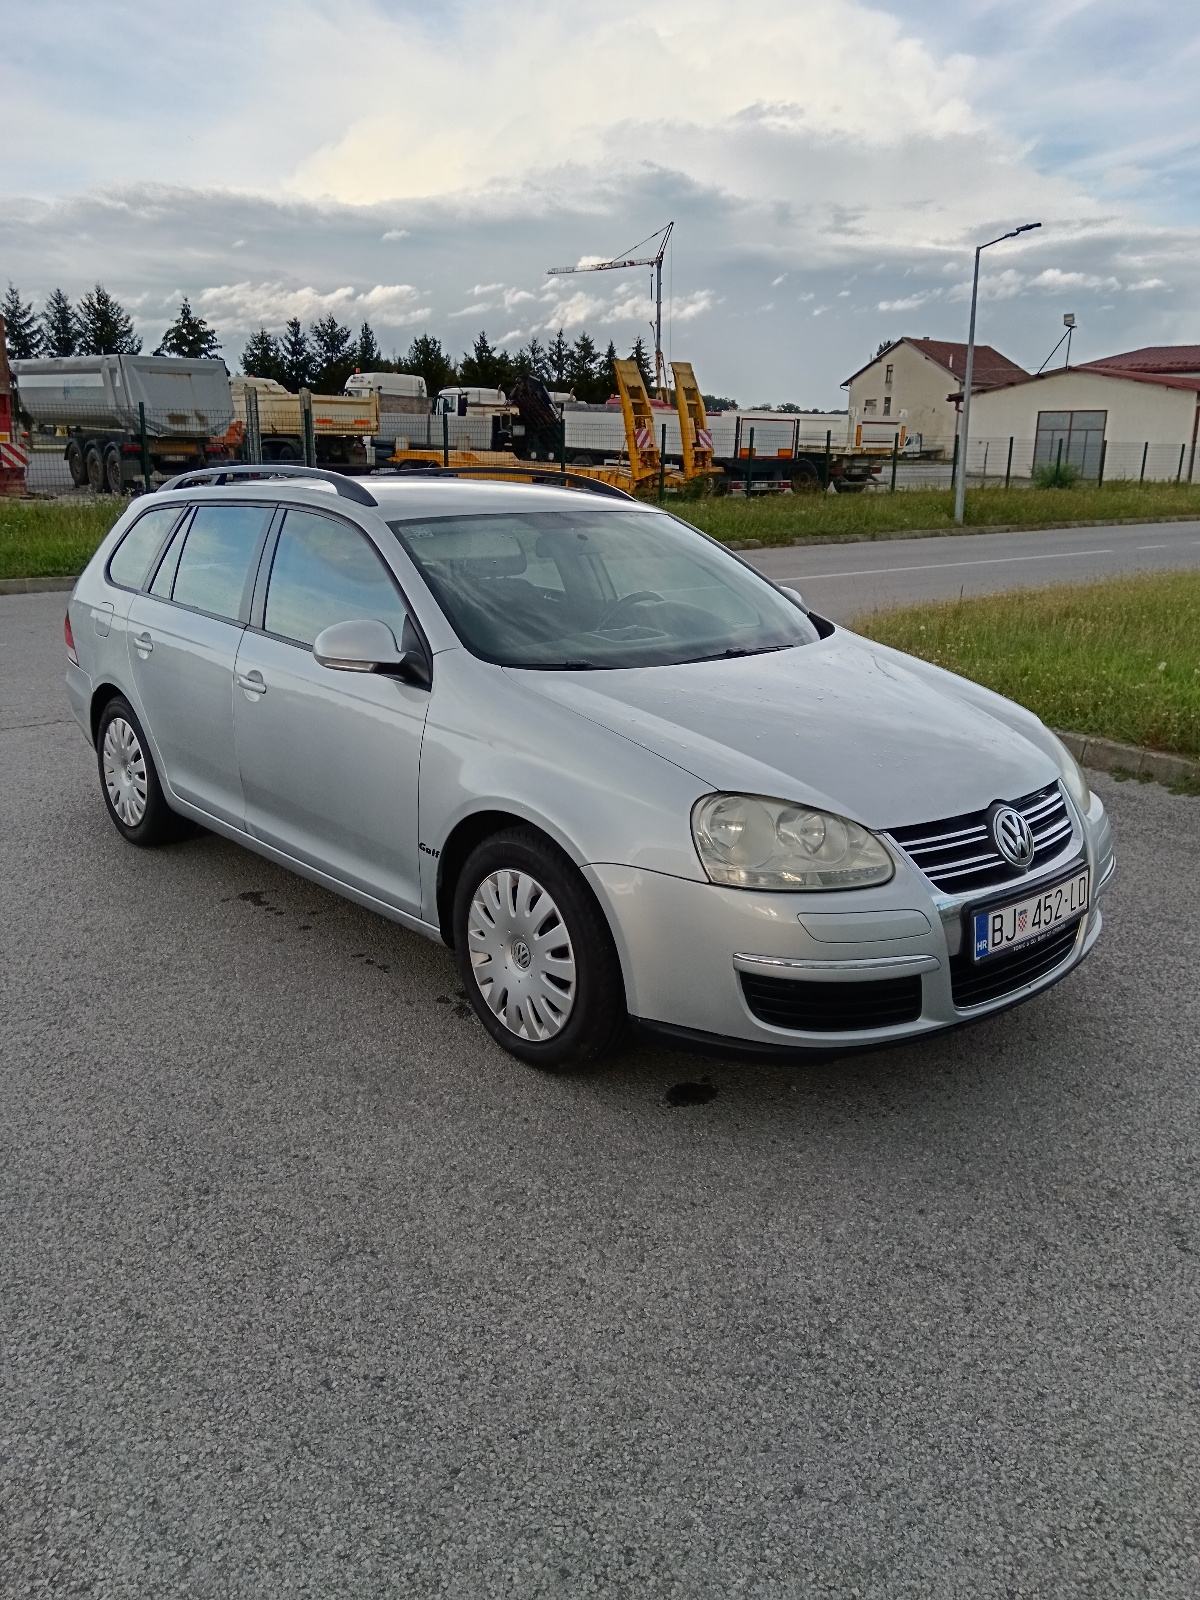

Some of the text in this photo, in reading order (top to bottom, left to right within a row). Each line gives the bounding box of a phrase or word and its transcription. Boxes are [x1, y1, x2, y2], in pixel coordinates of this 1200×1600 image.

[419, 842, 440, 858] Golf
[976, 939, 988, 952] HR
[991, 908, 1017, 948] BJ
[1031, 876, 1086, 929] 452-LD
